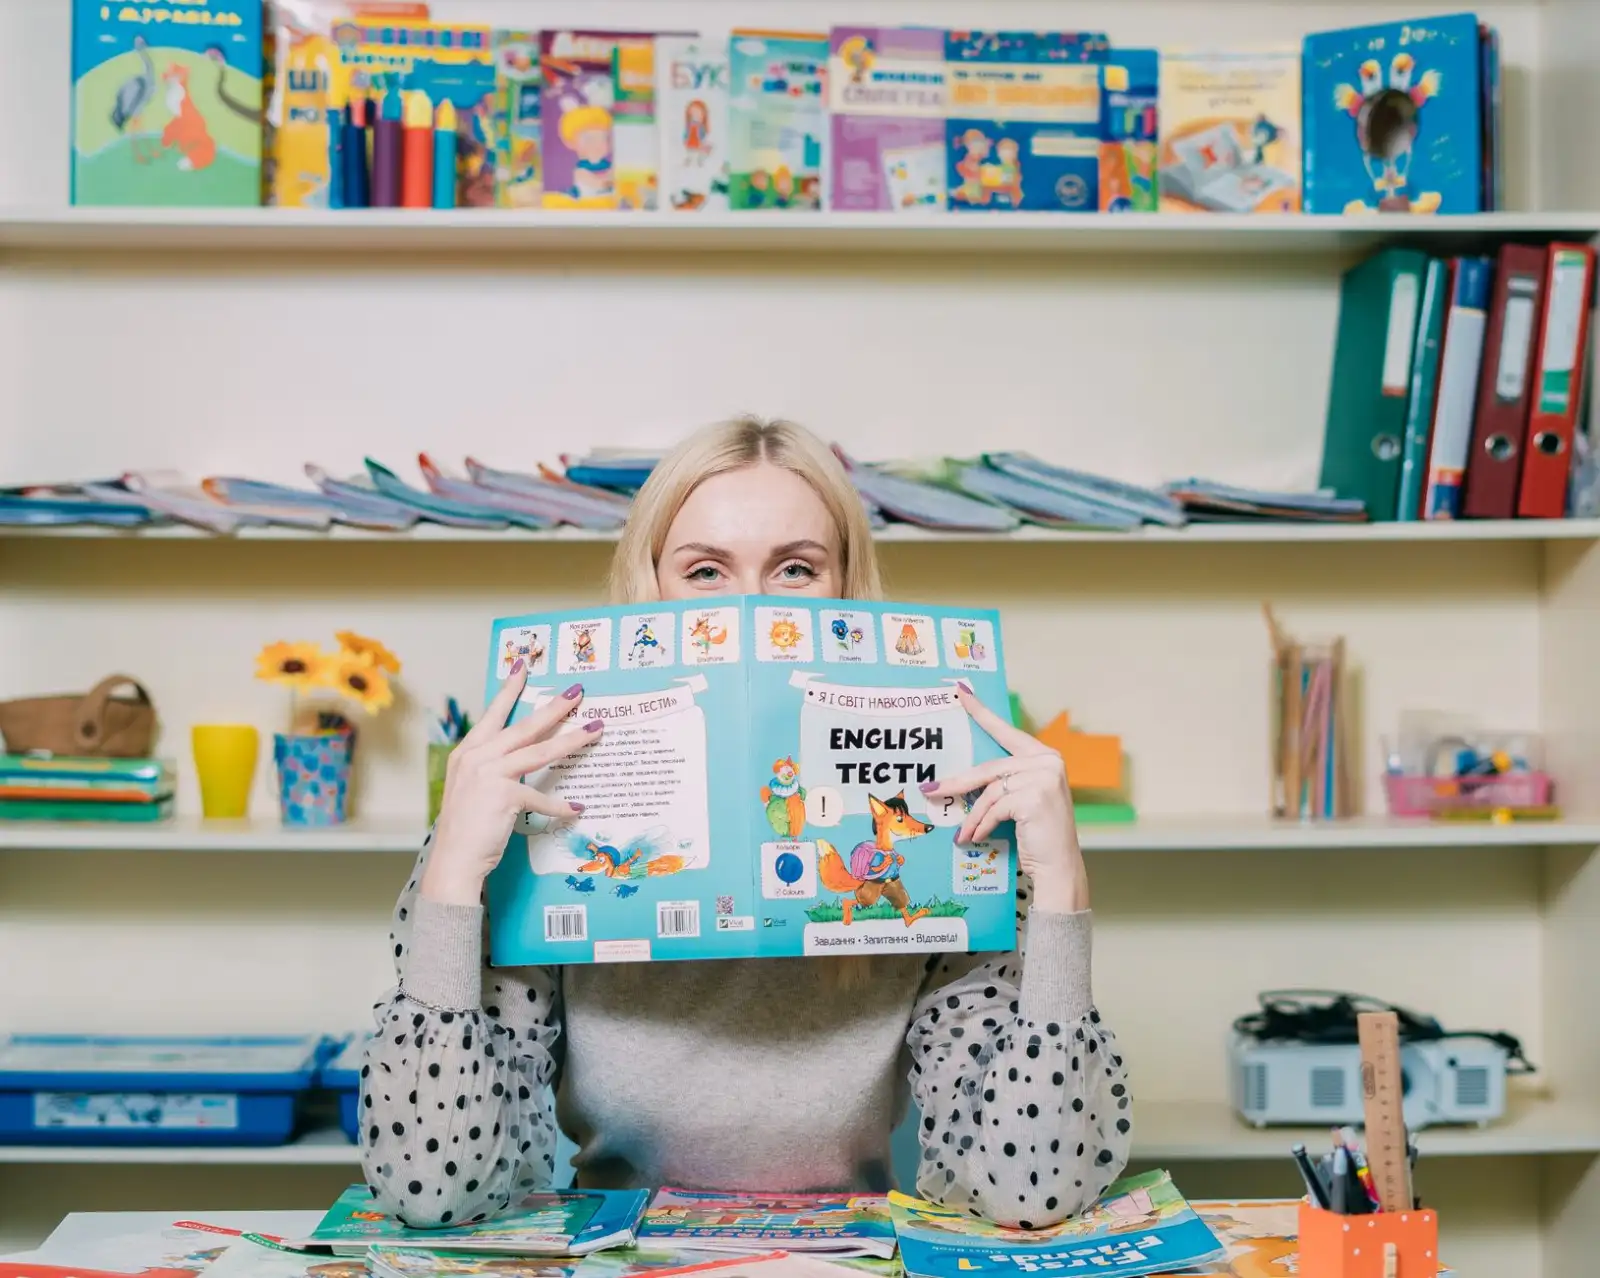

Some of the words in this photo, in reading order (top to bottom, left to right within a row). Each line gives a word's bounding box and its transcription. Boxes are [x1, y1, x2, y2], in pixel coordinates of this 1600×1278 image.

[818, 692, 826, 703] Я
[838, 694, 866, 708] СВІТ
[868, 693, 923, 710] НАВКОЛО
[925, 692, 952, 706] МЕНЕ
[829, 727, 944, 751] ENGLISH
[835, 762, 937, 785] ТЕСТИ
[814, 936, 856, 947] Завдання
[863, 934, 909, 945] Запитання
[916, 933, 959, 944] Відповіді
[989, 1235, 1164, 1263] Friends
[1018, 1248, 1147, 1273] First
